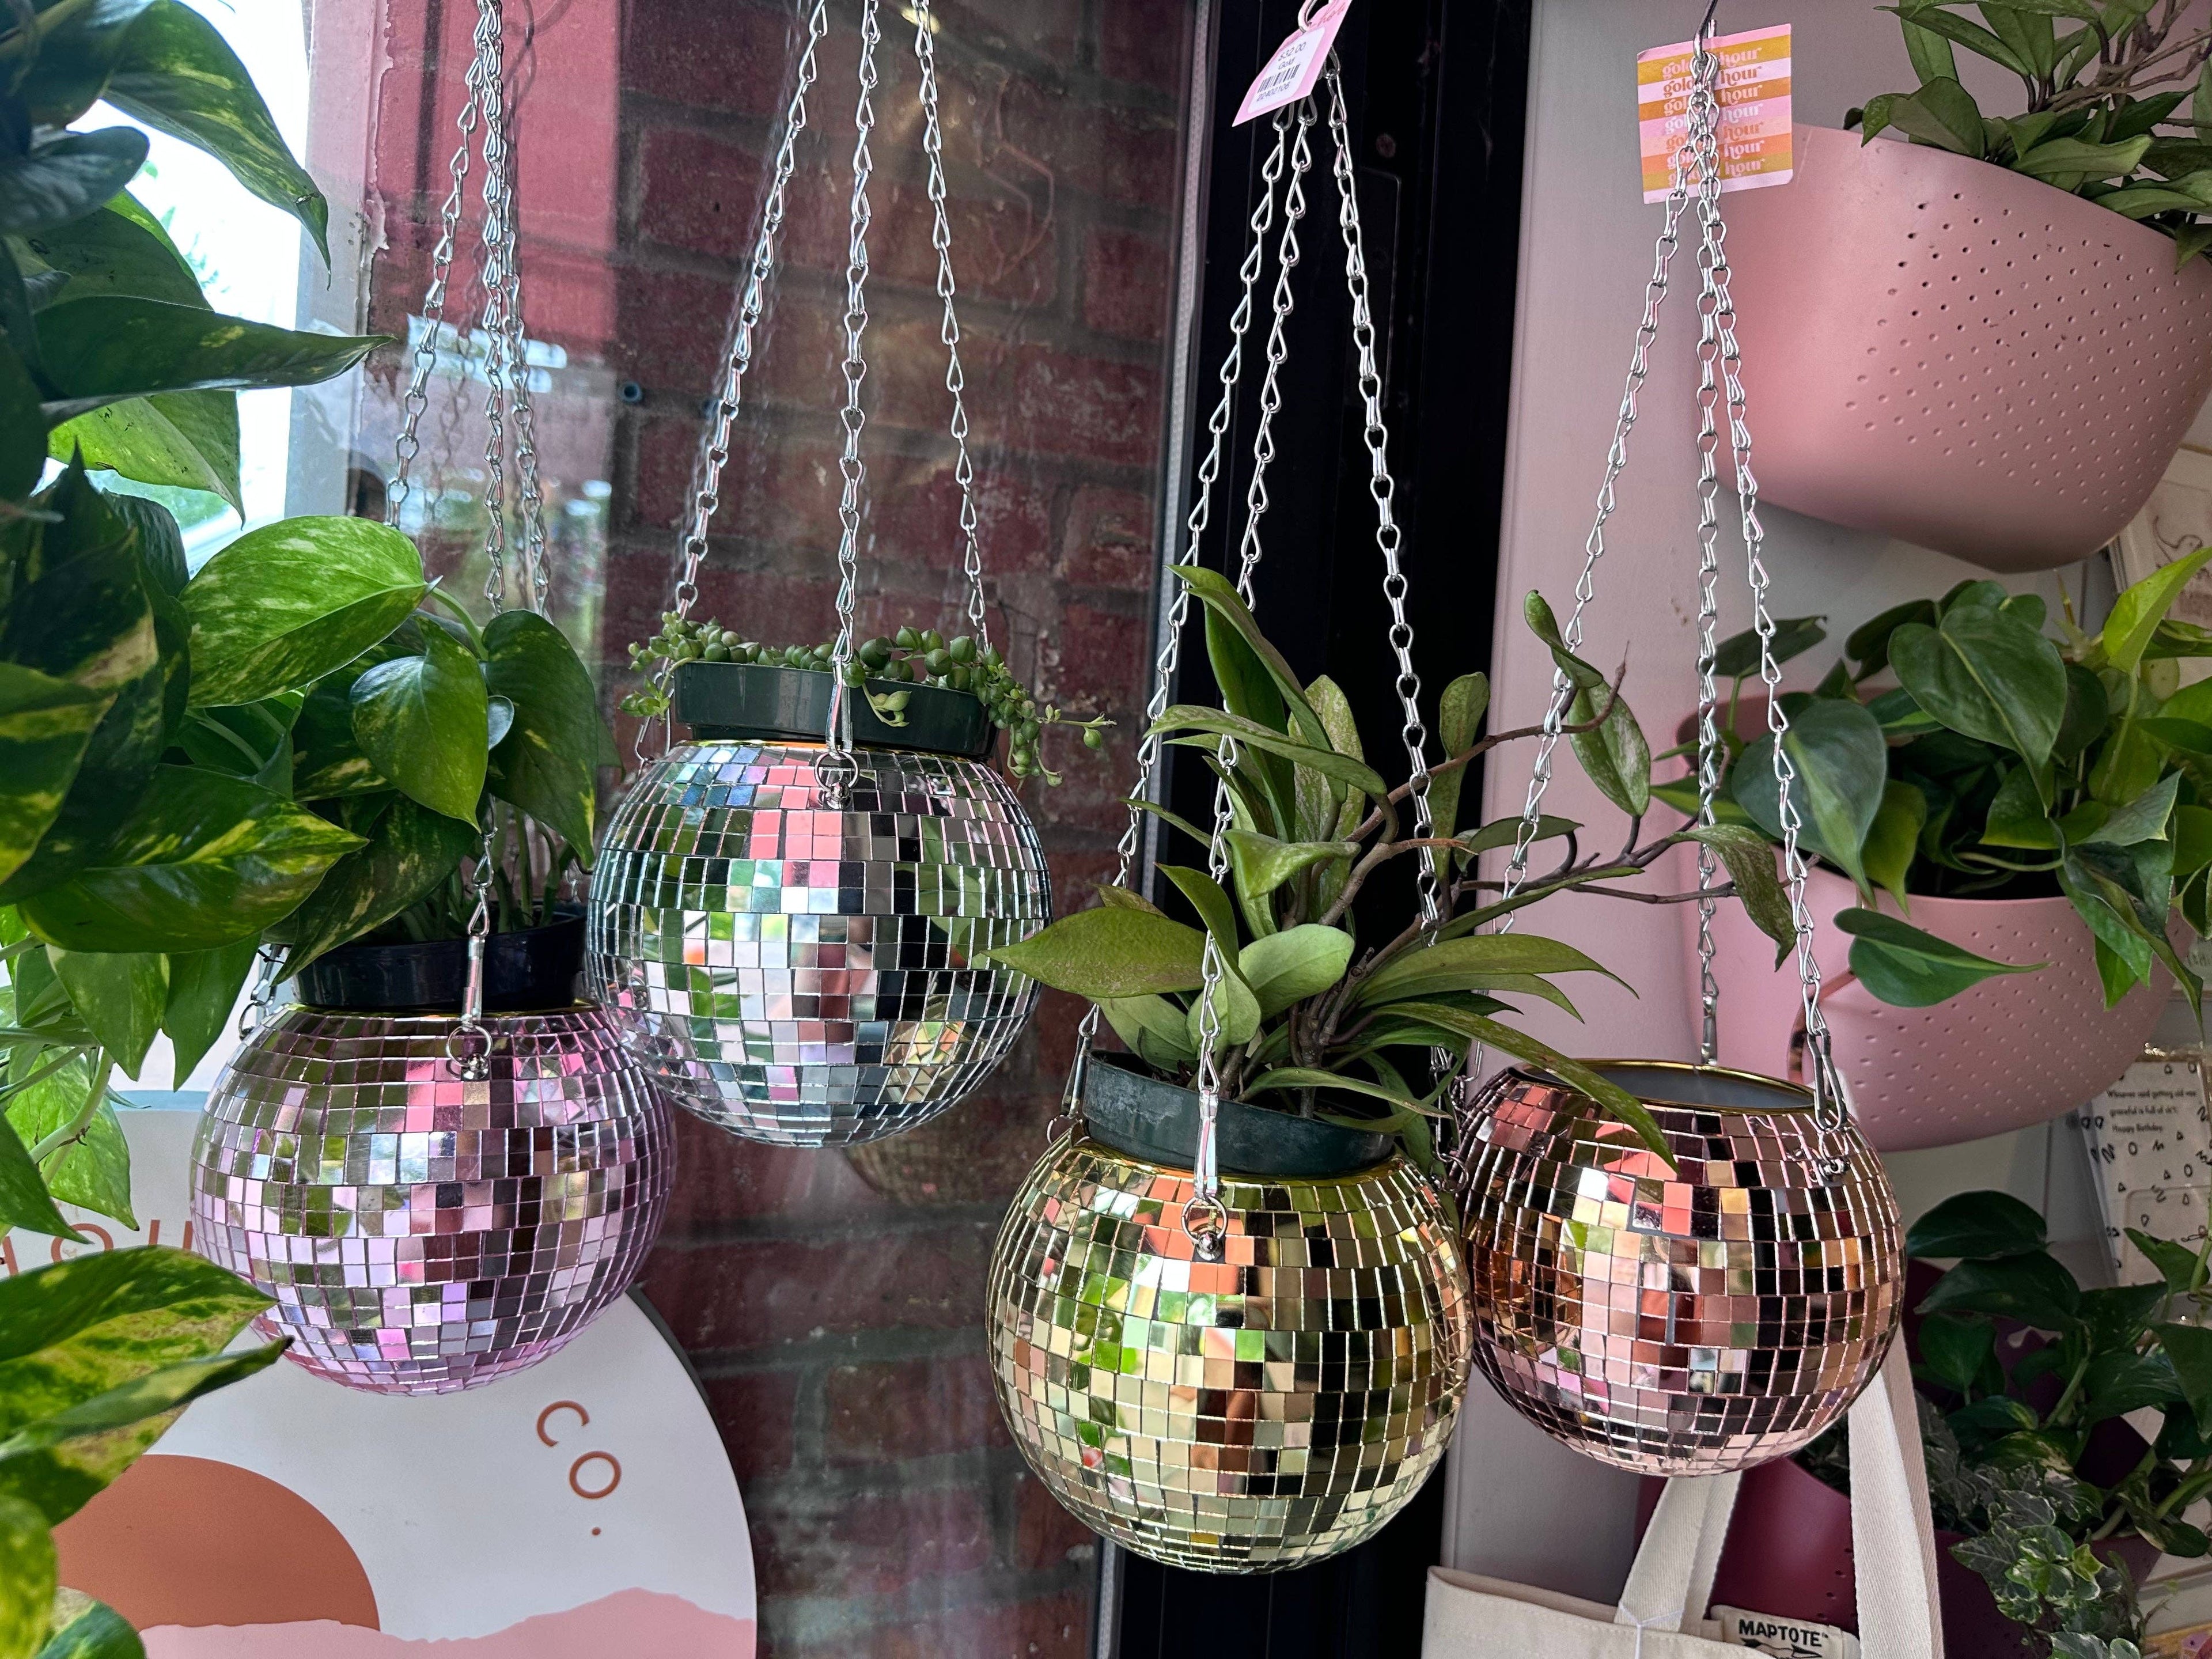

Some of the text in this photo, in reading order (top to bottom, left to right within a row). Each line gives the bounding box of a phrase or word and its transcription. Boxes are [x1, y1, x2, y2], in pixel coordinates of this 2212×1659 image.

[1278, 41, 1306, 61] $3200
[1719, 47, 1762, 67] hour
[1721, 66, 1762, 86] hour
[1721, 85, 1763, 105] hour
[1722, 103, 1763, 123] hour
[1724, 121, 1763, 141] hour
[1724, 140, 1764, 160] hour
[1725, 158, 1765, 177] hour
